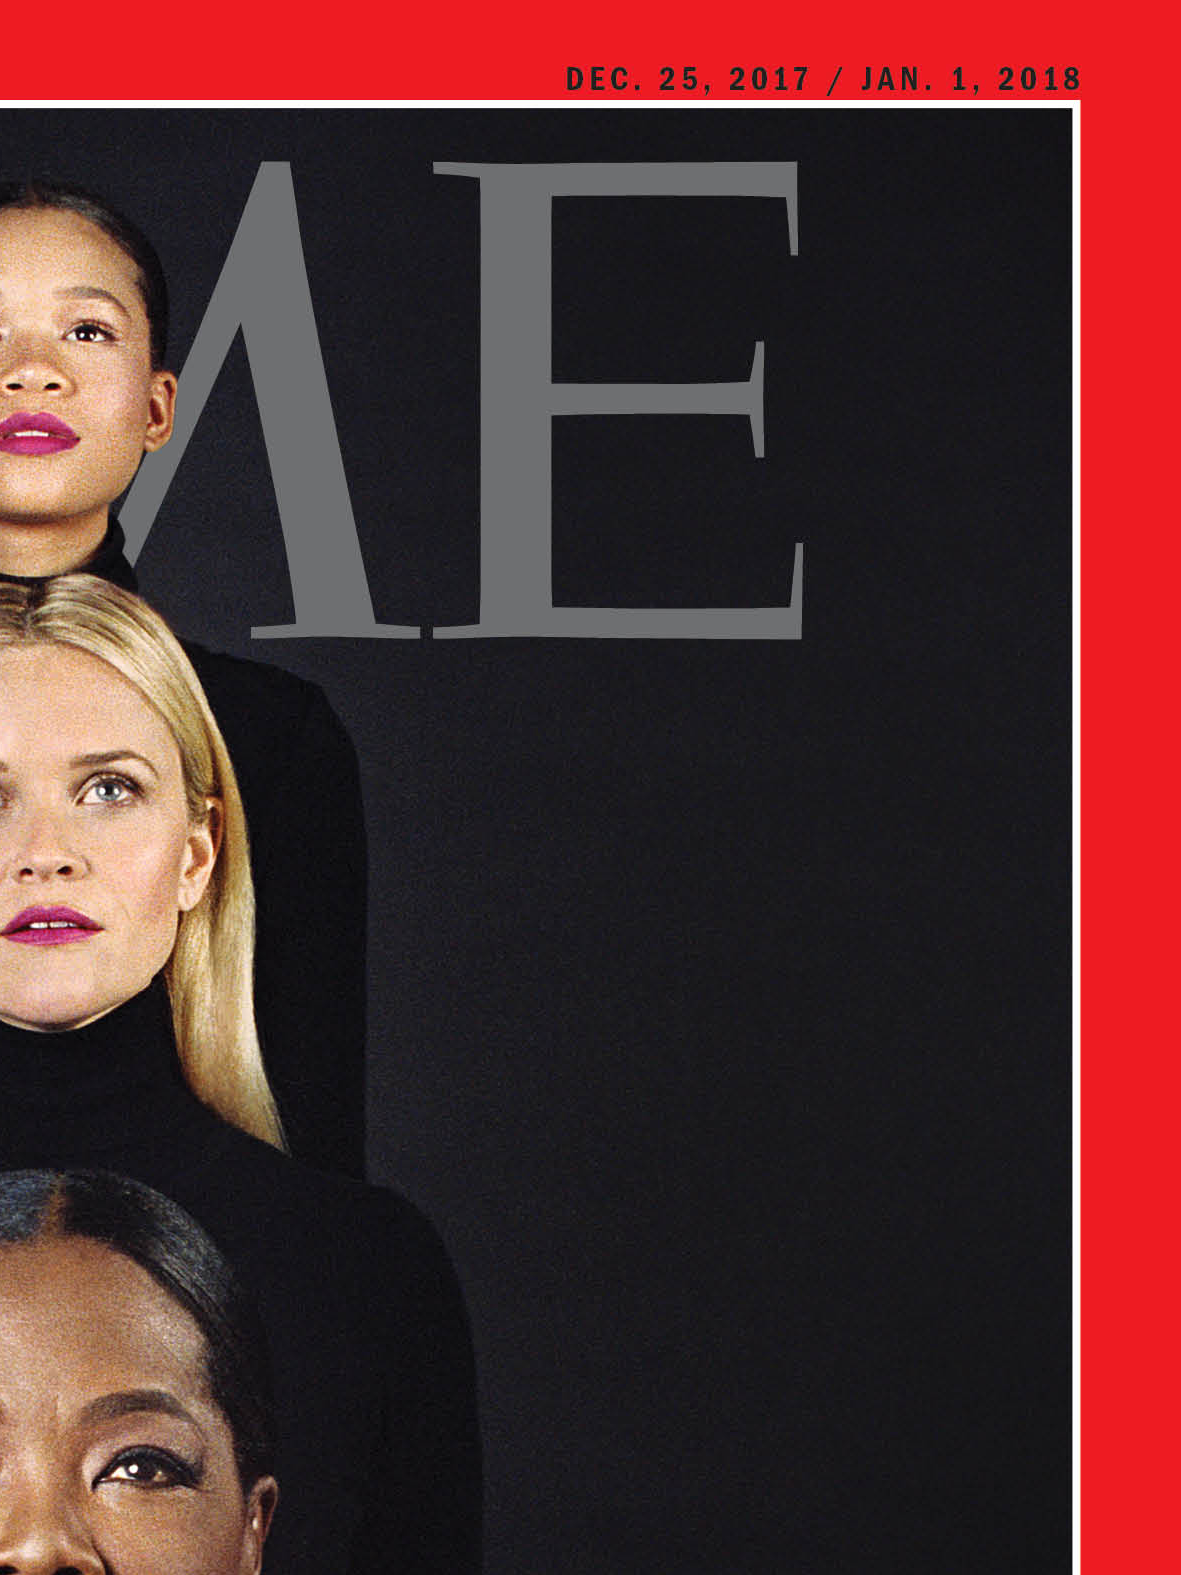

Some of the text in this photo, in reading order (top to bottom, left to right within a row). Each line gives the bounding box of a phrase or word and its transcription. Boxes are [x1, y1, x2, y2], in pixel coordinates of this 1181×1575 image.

[566, 66, 641, 91] DEC.
[659, 66, 711, 97] 25,
[729, 66, 808, 91] 2017
[861, 66, 931, 91] JAN.
[952, 66, 979, 96] 1,
[998, 66, 1080, 91] 2018
